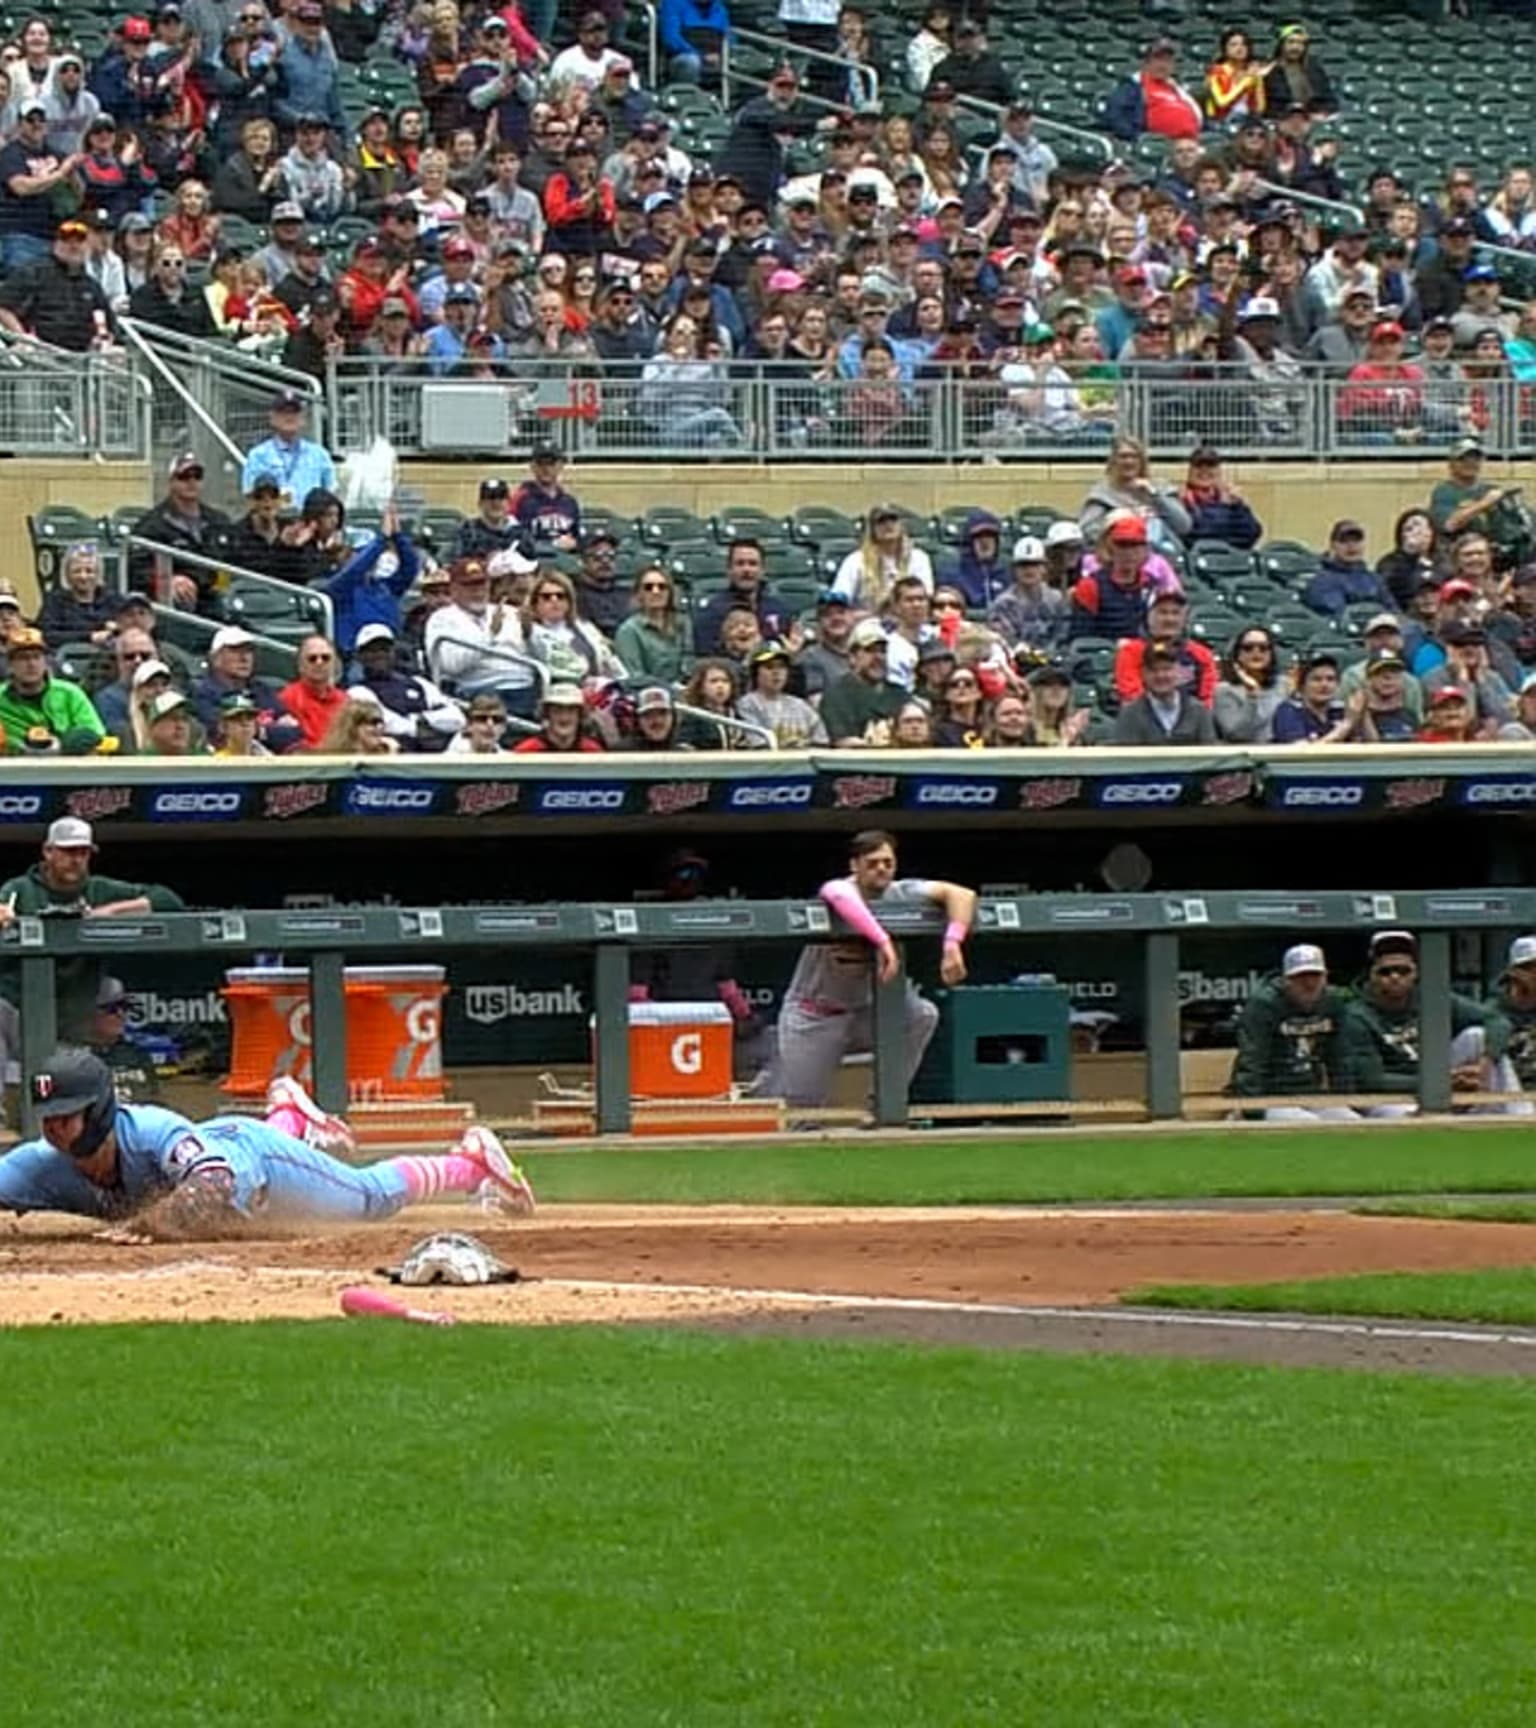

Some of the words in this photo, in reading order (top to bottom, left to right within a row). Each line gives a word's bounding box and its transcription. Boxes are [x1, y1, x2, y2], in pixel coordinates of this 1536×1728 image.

[568, 382, 597, 408] 13
[155, 792, 241, 813] GEICO
[542, 789, 624, 809] GEICO
[732, 783, 812, 806] GEICO
[917, 784, 998, 804] GEICO
[1102, 783, 1182, 803] GEICO
[1284, 786, 1362, 805] GEICO
[406, 999, 441, 1042] G
[671, 1032, 702, 1075] G
